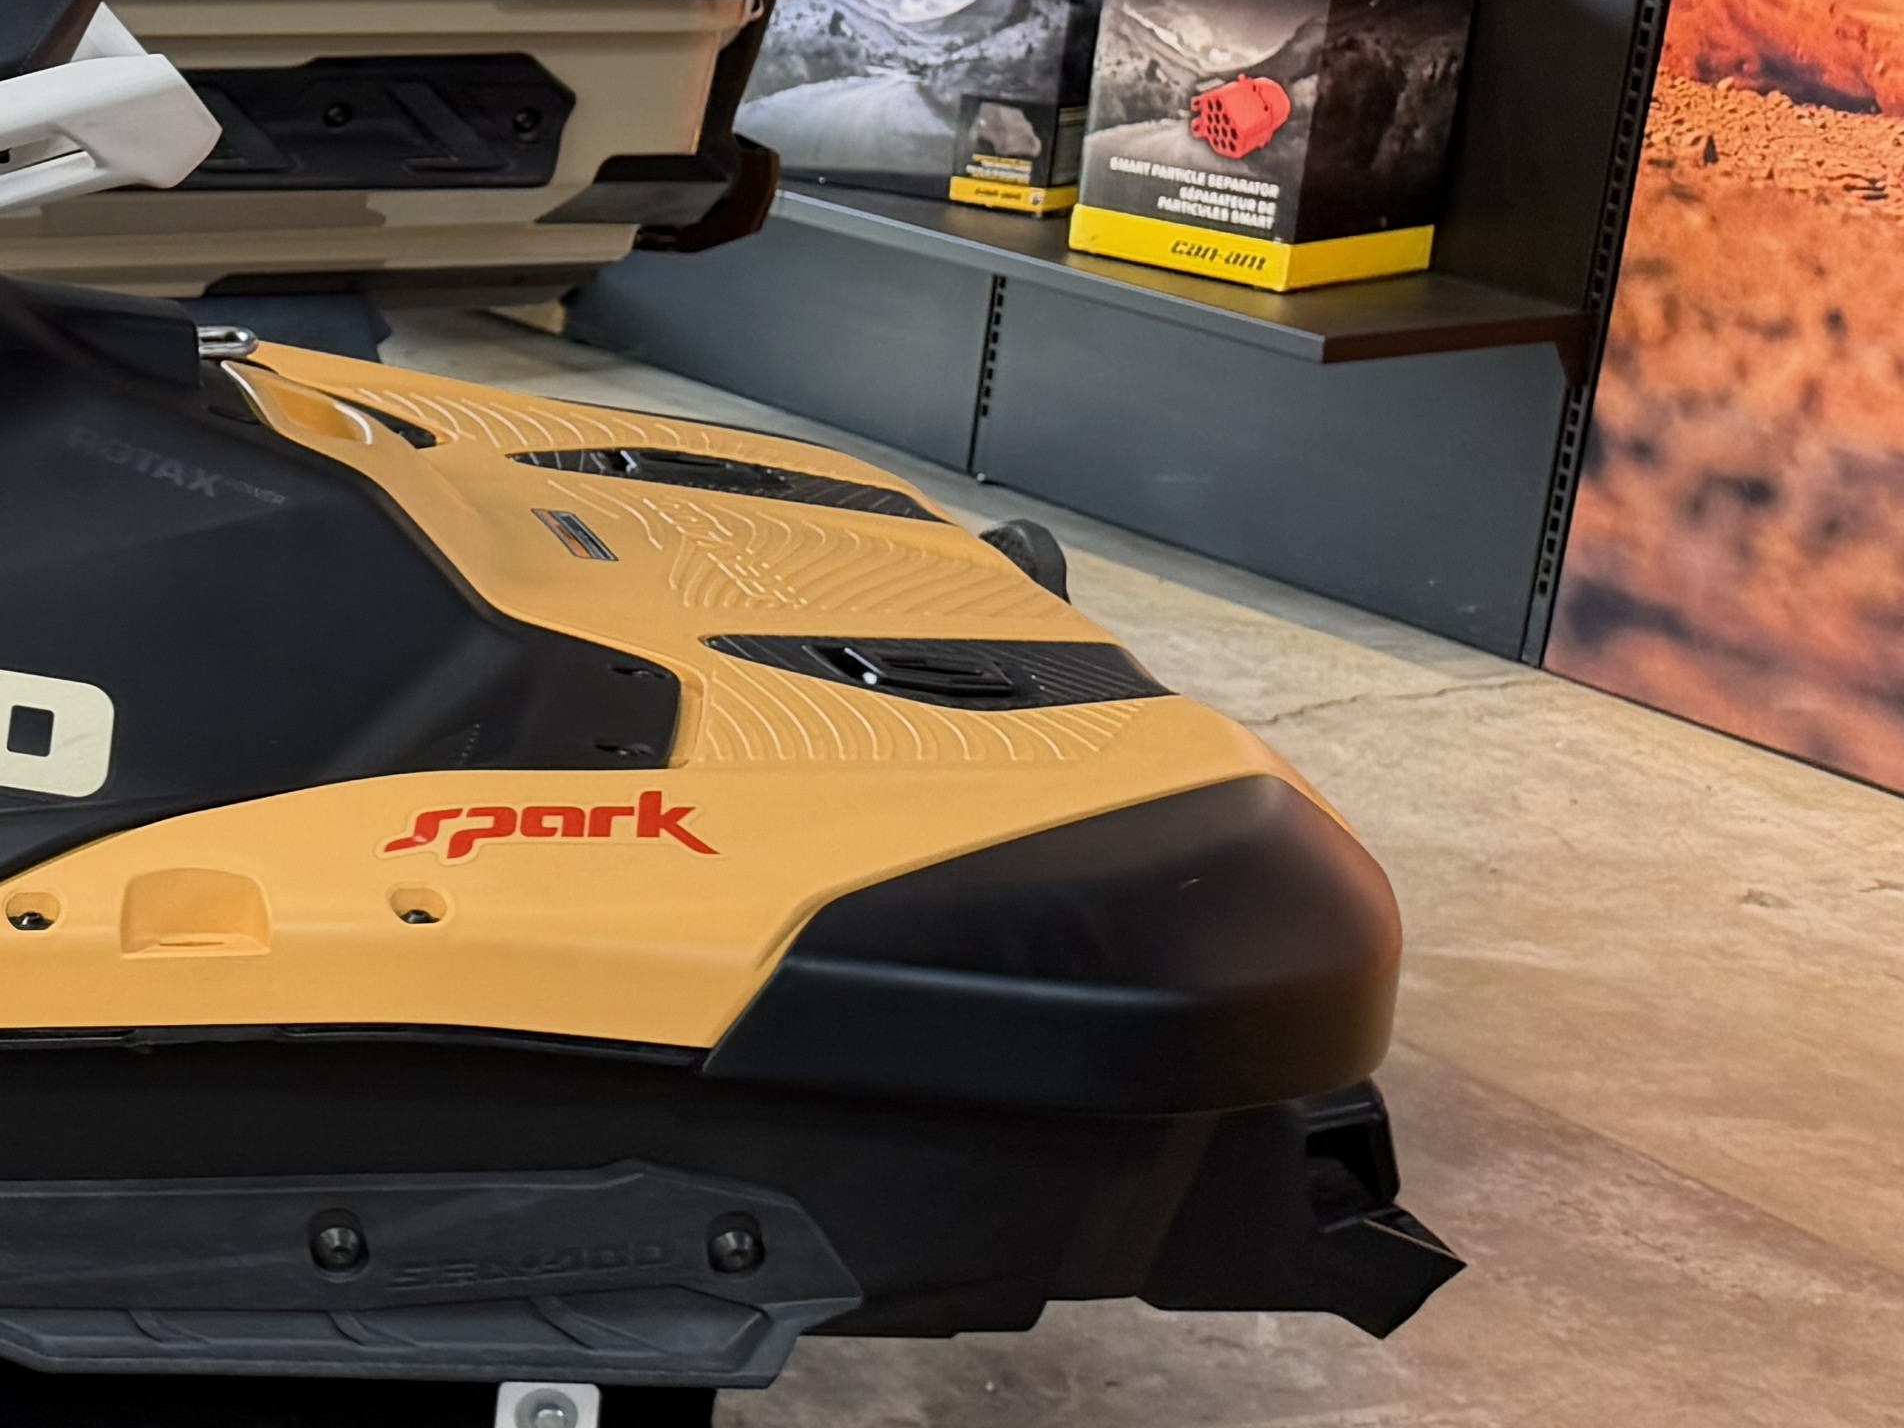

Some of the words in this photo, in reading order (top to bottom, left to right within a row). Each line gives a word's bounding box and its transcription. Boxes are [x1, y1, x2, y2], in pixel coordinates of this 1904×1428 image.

[1110, 157, 1151, 175] SMART
[1151, 163, 1206, 185] PARTICLE
[1208, 173, 1280, 199] SEPARATOR
[1157, 196, 1229, 222] PARTICULES
[1230, 210, 1274, 230] SMART
[1258, 200, 1276, 216] DE
[1171, 240, 1266, 271] can-am
[384, 790, 720, 859] spark
